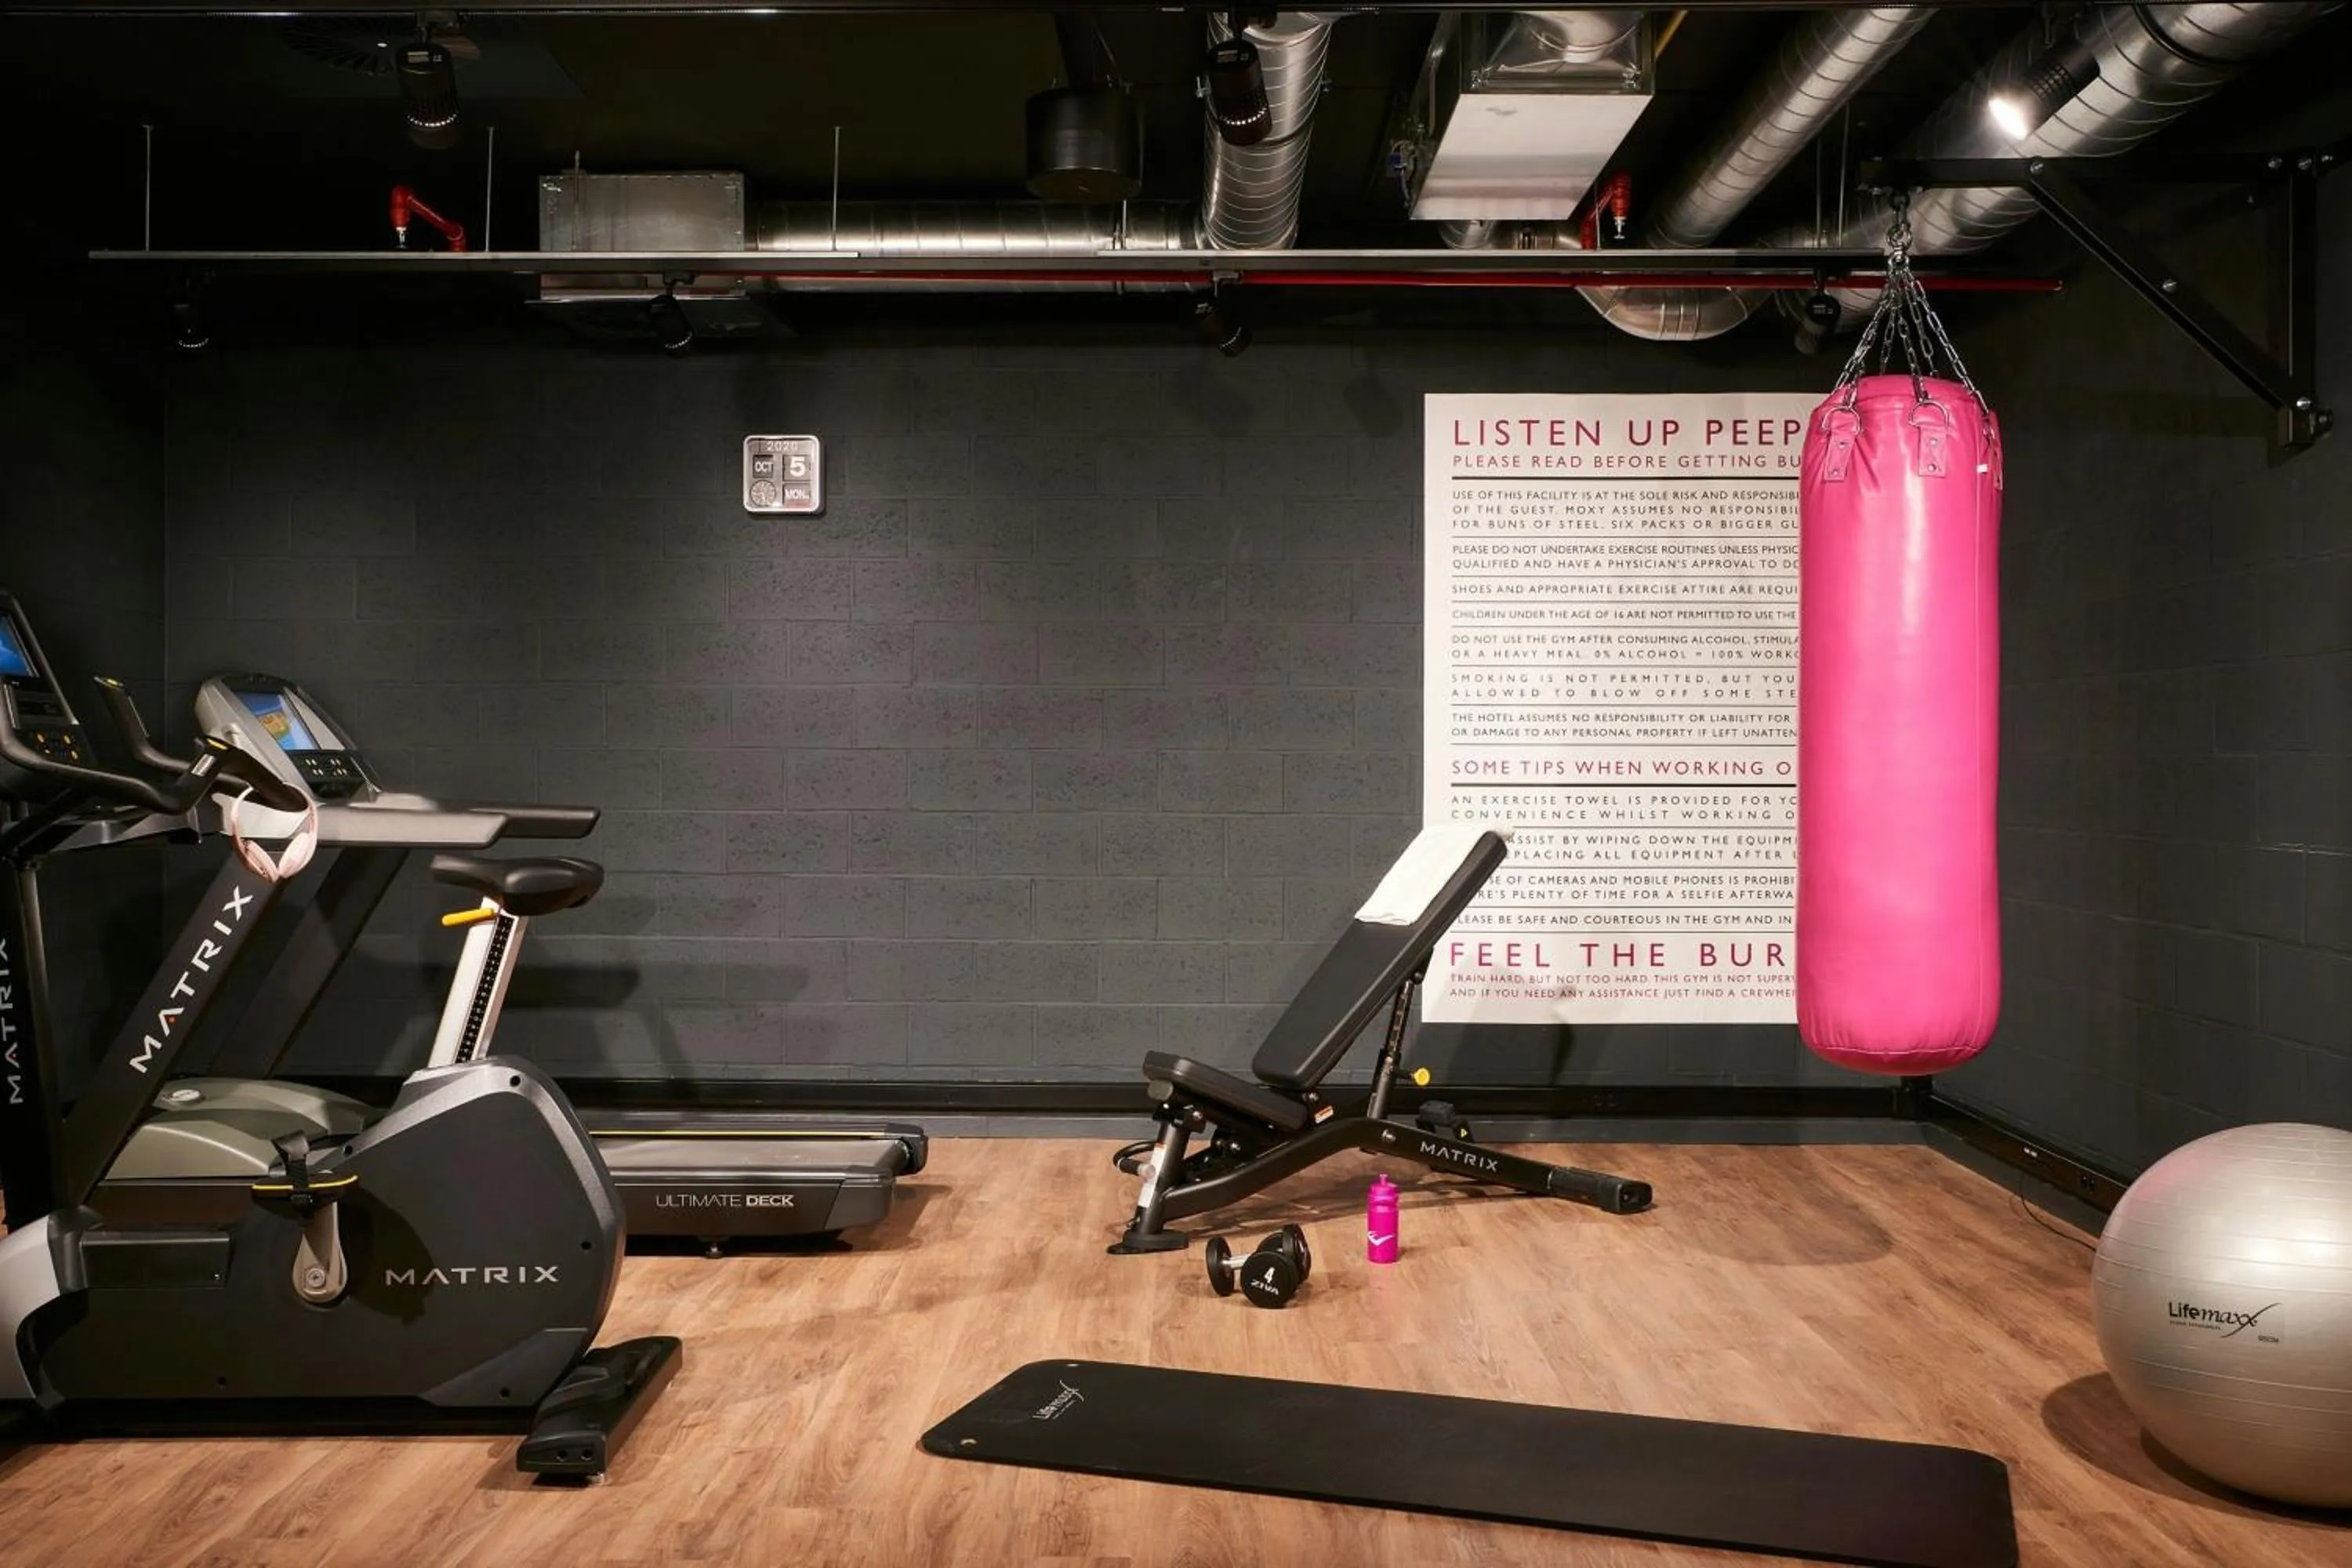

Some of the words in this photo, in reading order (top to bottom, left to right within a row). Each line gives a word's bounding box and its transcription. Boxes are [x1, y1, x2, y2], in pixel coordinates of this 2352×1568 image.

[1454, 419, 1600, 446] LISTEN
[1628, 419, 1679, 446] UP
[767, 441, 798, 452] 2020
[755, 461, 774, 472] OCT
[789, 456, 806, 477] 5
[1453, 455, 1520, 468] PLEASE
[1531, 455, 1583, 468] READ
[1594, 455, 1667, 468] BEFORE
[1677, 455, 1767, 468] GETTING
[1452, 490, 1473, 501] USE
[1477, 490, 1494, 501] OF
[1497, 490, 1523, 501] THIS
[1526, 490, 1578, 501] FACILITY
[1581, 490, 1592, 501] IS
[1594, 490, 1610, 501] AT
[1613, 490, 1635, 501] THE
[1639, 490, 1668, 501] SOLE
[1672, 490, 1698, 501] RISK
[1700, 490, 1729, 501] AND
[1476, 505, 1502, 516] THE
[1565, 505, 1605, 516] MOXY
[1611, 505, 1674, 516] ASSUMES
[1681, 505, 1703, 516] NO
[1533, 519, 1552, 530] OF
[1610, 519, 1634, 530] SIX
[1641, 519, 1686, 530] PACKS
[1693, 519, 1712, 530] OR
[1719, 519, 1773, 530] BIGGER
[1452, 544, 1489, 555] PLEASE
[1491, 544, 1510, 555] DO
[1512, 544, 1537, 555] NOT
[1541, 544, 1605, 555] UNDERTAKE
[1608, 544, 1658, 555] EXERCISE
[1661, 544, 1716, 555] ROUTINES
[1718, 544, 1759, 555] UNLESS
[1452, 558, 1519, 570] QUALIFIED
[1523, 558, 1552, 570] AND
[1557, 558, 1590, 570] HAVE
[1607, 558, 1688, 570] PHYSICIAN'S
[1691, 558, 1755, 570] APPROVAL
[1759, 558, 1779, 570] TO
[1452, 584, 1492, 595] SHOES
[1496, 584, 1525, 595] AND
[1528, 584, 1613, 595] APPROPRIATE
[1618, 584, 1678, 595] EXERCISE
[1681, 584, 1725, 595] ATTIRE
[1548, 609, 1569, 620] THE
[1570, 609, 1591, 620] AGE
[1650, 609, 1673, 620] NOT
[1754, 609, 1774, 620] USE
[1777, 609, 1796, 620] THE
[1451, 634, 1471, 645] DO
[1473, 634, 1497, 645] NOT
[1502, 634, 1522, 645] USE
[1526, 634, 1547, 645] THE
[1551, 634, 1576, 645] GYM
[1578, 634, 1613, 645] AFTER
[1617, 634, 1689, 645] CONSUMING
[1493, 649, 1537, 660] HEAVY
[1617, 649, 1686, 660] ALCOHOL
[1711, 649, 1744, 660] 100%
[1451, 673, 1528, 684] SMOKING
[1565, 673, 1598, 684] NOT
[1762, 673, 1795, 684] YOU
[1590, 688, 1641, 699] BLOW
[1703, 688, 1751, 699] SOME
[1452, 713, 1474, 724] THE
[1477, 713, 1514, 724] HOTEL
[1518, 713, 1567, 724] ASSUMES
[1571, 713, 1591, 724] NO
[1594, 713, 1684, 724] RESPONSIBILITY
[1688, 713, 1705, 724] OR
[1710, 713, 1763, 724] LIABILITY
[1768, 713, 1791, 724] FOR
[1451, 728, 1468, 739] OR
[1472, 728, 1520, 739] DAMAGE
[1524, 728, 1541, 739] TO
[1543, 728, 1567, 739] ANY
[1572, 728, 1632, 739] PERSONAL
[1636, 728, 1693, 739] PROPERTY
[1711, 728, 1738, 739] LEFT
[1451, 760, 1510, 775] SOME
[1519, 760, 1565, 775] TIPS
[1575, 760, 1642, 775] WHEN
[1652, 760, 1763, 775] WORKING
[1451, 795, 1472, 806] AN
[1481, 795, 1556, 806] EXERCISE
[1565, 795, 1618, 806] TOWEL
[1650, 795, 1732, 806] PROVIDED
[1740, 795, 1771, 806] FOR
[1450, 809, 1587, 820] CONVENIENCE
[1599, 809, 1669, 820] WHILST
[1681, 809, 1771, 820] WORKING
[1563, 835, 1579, 846] BY
[1585, 835, 1641, 846] WIPING
[1648, 835, 1696, 846] DOWN
[1702, 835, 1729, 846] THE
[1593, 850, 1621, 861] ALL
[1631, 850, 1724, 861] EQUIPMENT
[1733, 850, 1782, 861] AFTER
[1506, 875, 1523, 886] OF
[1527, 875, 1586, 886] CAMERAS
[1589, 875, 1617, 886] AND
[1623, 875, 1668, 886] MOBILE
[1673, 875, 1724, 886] PHONES
[1512, 890, 1564, 900] PLENTY
[1570, 890, 1589, 900] OF
[1594, 890, 1626, 900] TIME
[1633, 890, 1660, 900] FOR
[1681, 890, 1724, 900] SELFIE
[1498, 915, 1512, 925] BE
[1517, 915, 1545, 925] SAFE
[1550, 915, 1578, 925] AND
[1583, 915, 1661, 925] COURTEOUS
[1665, 915, 1680, 925] IN
[1683, 915, 1708, 925] THE
[1713, 915, 1741, 925] GYM
[1744, 915, 1773, 925] AND
[1450, 943, 1550, 967] FEEL
[1579, 943, 1664, 967] THE
[129, 885, 254, 1073] MATRIX
[0, 938, 24, 1105] MATRIX
[1419, 1141, 1499, 1173] MATRIX
[655, 1194, 742, 1207] ULTIMATE
[746, 1194, 795, 1207] DECK
[385, 1265, 560, 1286] MATRIX
[1264, 1266, 1275, 1284] 4
[1250, 1279, 1279, 1295] ZIVA
